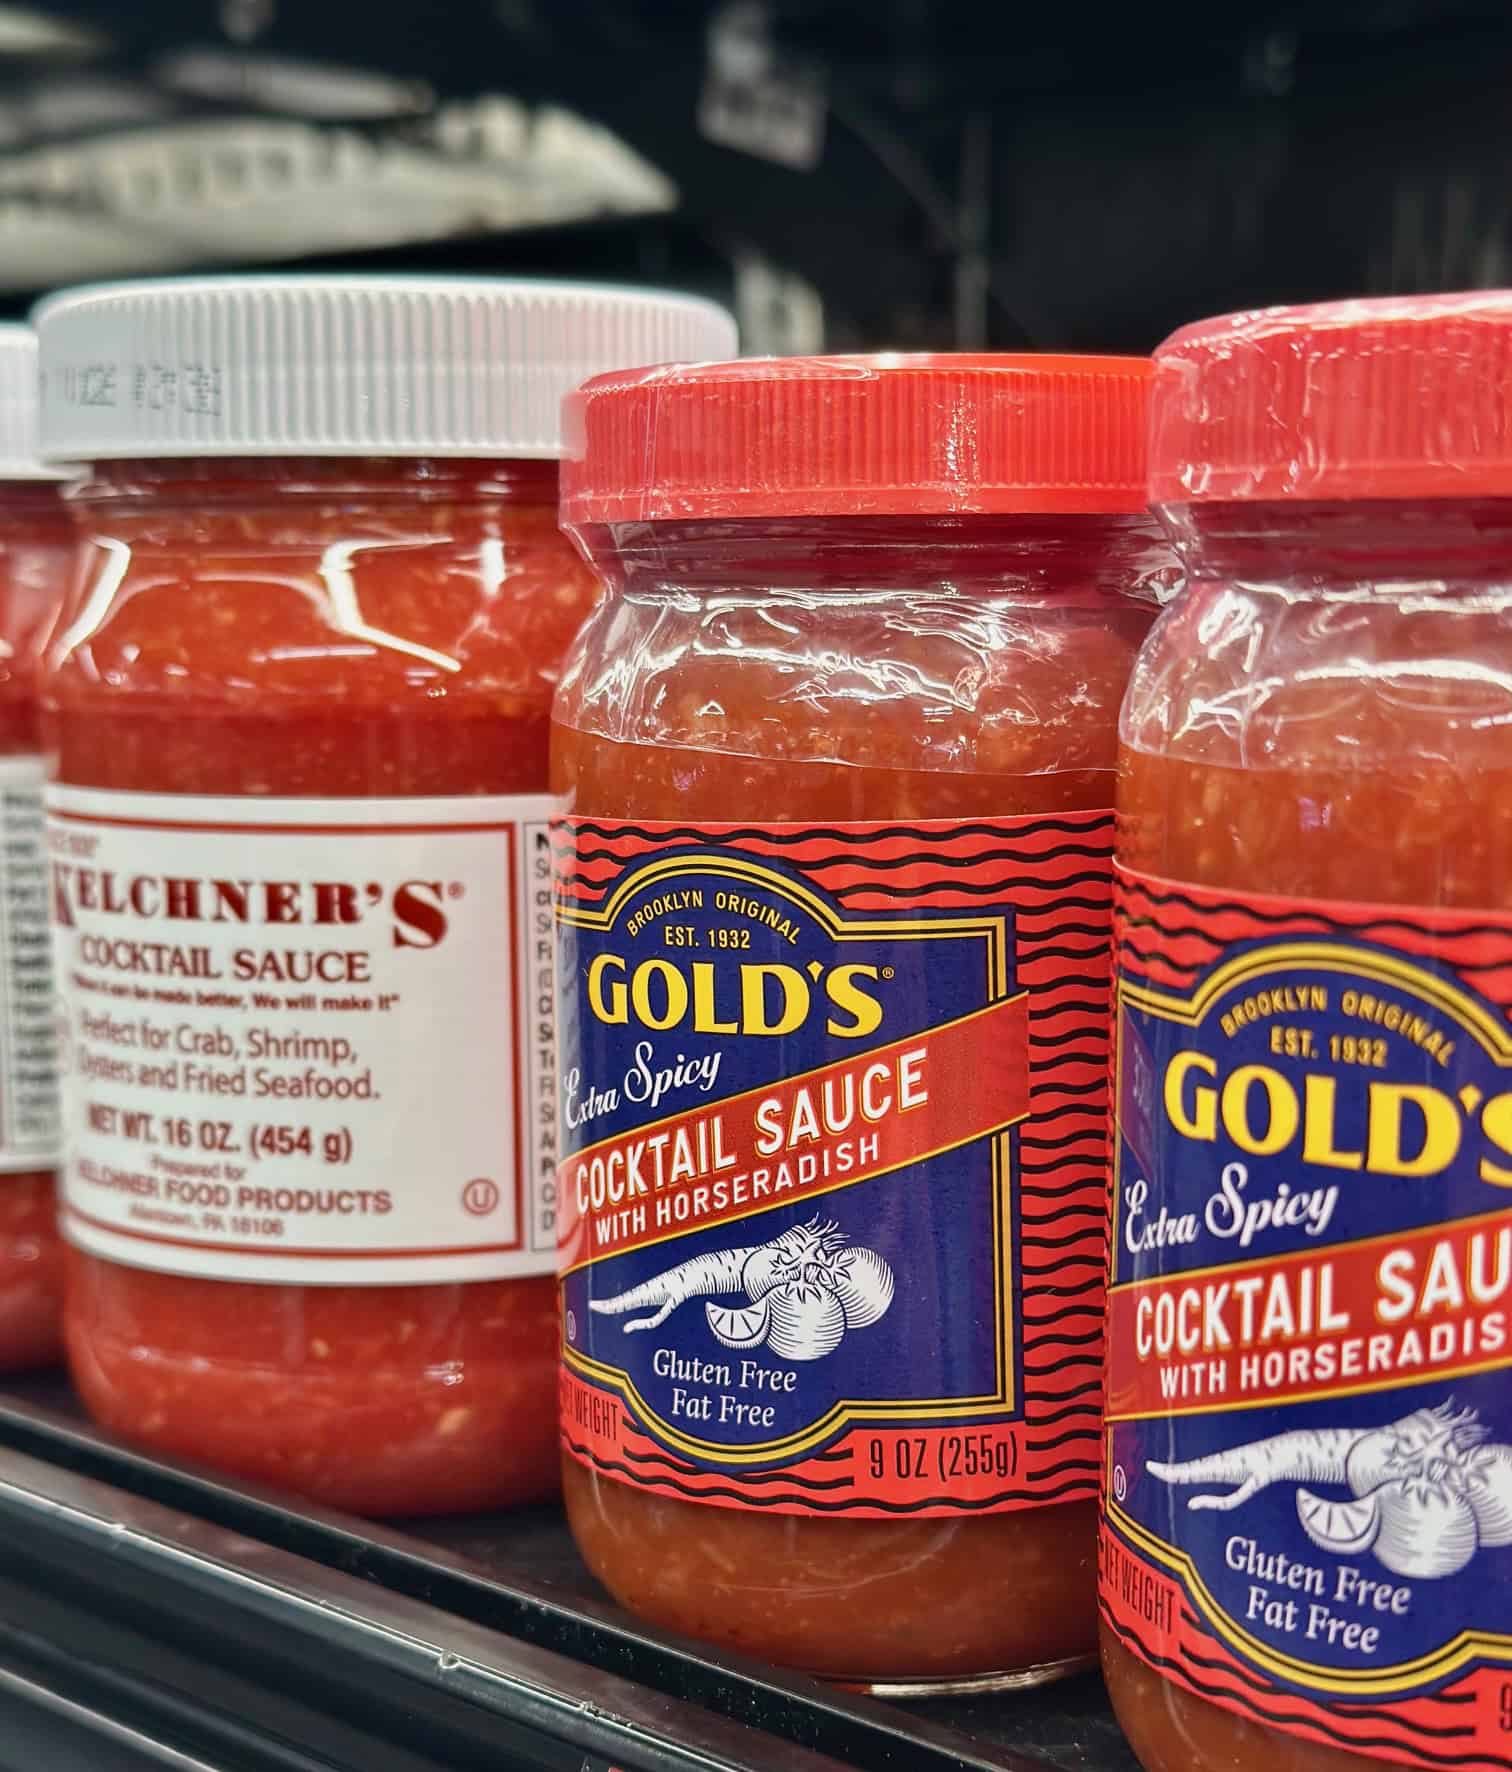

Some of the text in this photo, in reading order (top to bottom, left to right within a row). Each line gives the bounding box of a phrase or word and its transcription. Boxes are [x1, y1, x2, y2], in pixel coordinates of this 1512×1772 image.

[626, 890, 800, 945] BROOKLYN ORIGINAL
[664, 926, 750, 949] EST. 1932
[80, 934, 371, 983] COCKTAIL SAUCE
[286, 994, 316, 1010] will
[323, 996, 372, 1012] make
[1221, 988, 1456, 1069] BROOKLYN ORIGINAL
[176, 1023, 241, 1062] Crab,
[247, 1028, 358, 1065] Shrimp,
[1270, 1027, 1387, 1066] EST. 1932
[138, 1060, 177, 1090] and
[184, 1064, 246, 1095] Fried
[254, 1068, 381, 1099] Seafood.
[564, 1041, 722, 1129] Extra Spicy
[163, 1118, 192, 1148] 16
[199, 1120, 240, 1152] OZ.
[249, 1125, 312, 1160] (454
[322, 1127, 353, 1163] g)
[575, 1047, 929, 1217] COCKTAIL SAUCE
[164, 1177, 229, 1207] FOOD
[237, 1184, 393, 1214] PRODUCTS
[595, 1133, 880, 1245] WITH HORSERADISH
[1124, 1162, 1339, 1254] Extra Spicy
[1135, 1263, 1352, 1360] COCKTAIL
[653, 1348, 798, 1393] Gluten Free
[1160, 1361, 1227, 1399] WITH
[575, 1390, 619, 1441] WEIGHT
[671, 1387, 776, 1428] Fat Free
[870, 1431, 1017, 1483] 9 OZ (255g)
[1121, 1556, 1175, 1635] WEIGHT
[1224, 1535, 1412, 1615] Gluten Free
[1245, 1587, 1380, 1654] Fat Free
